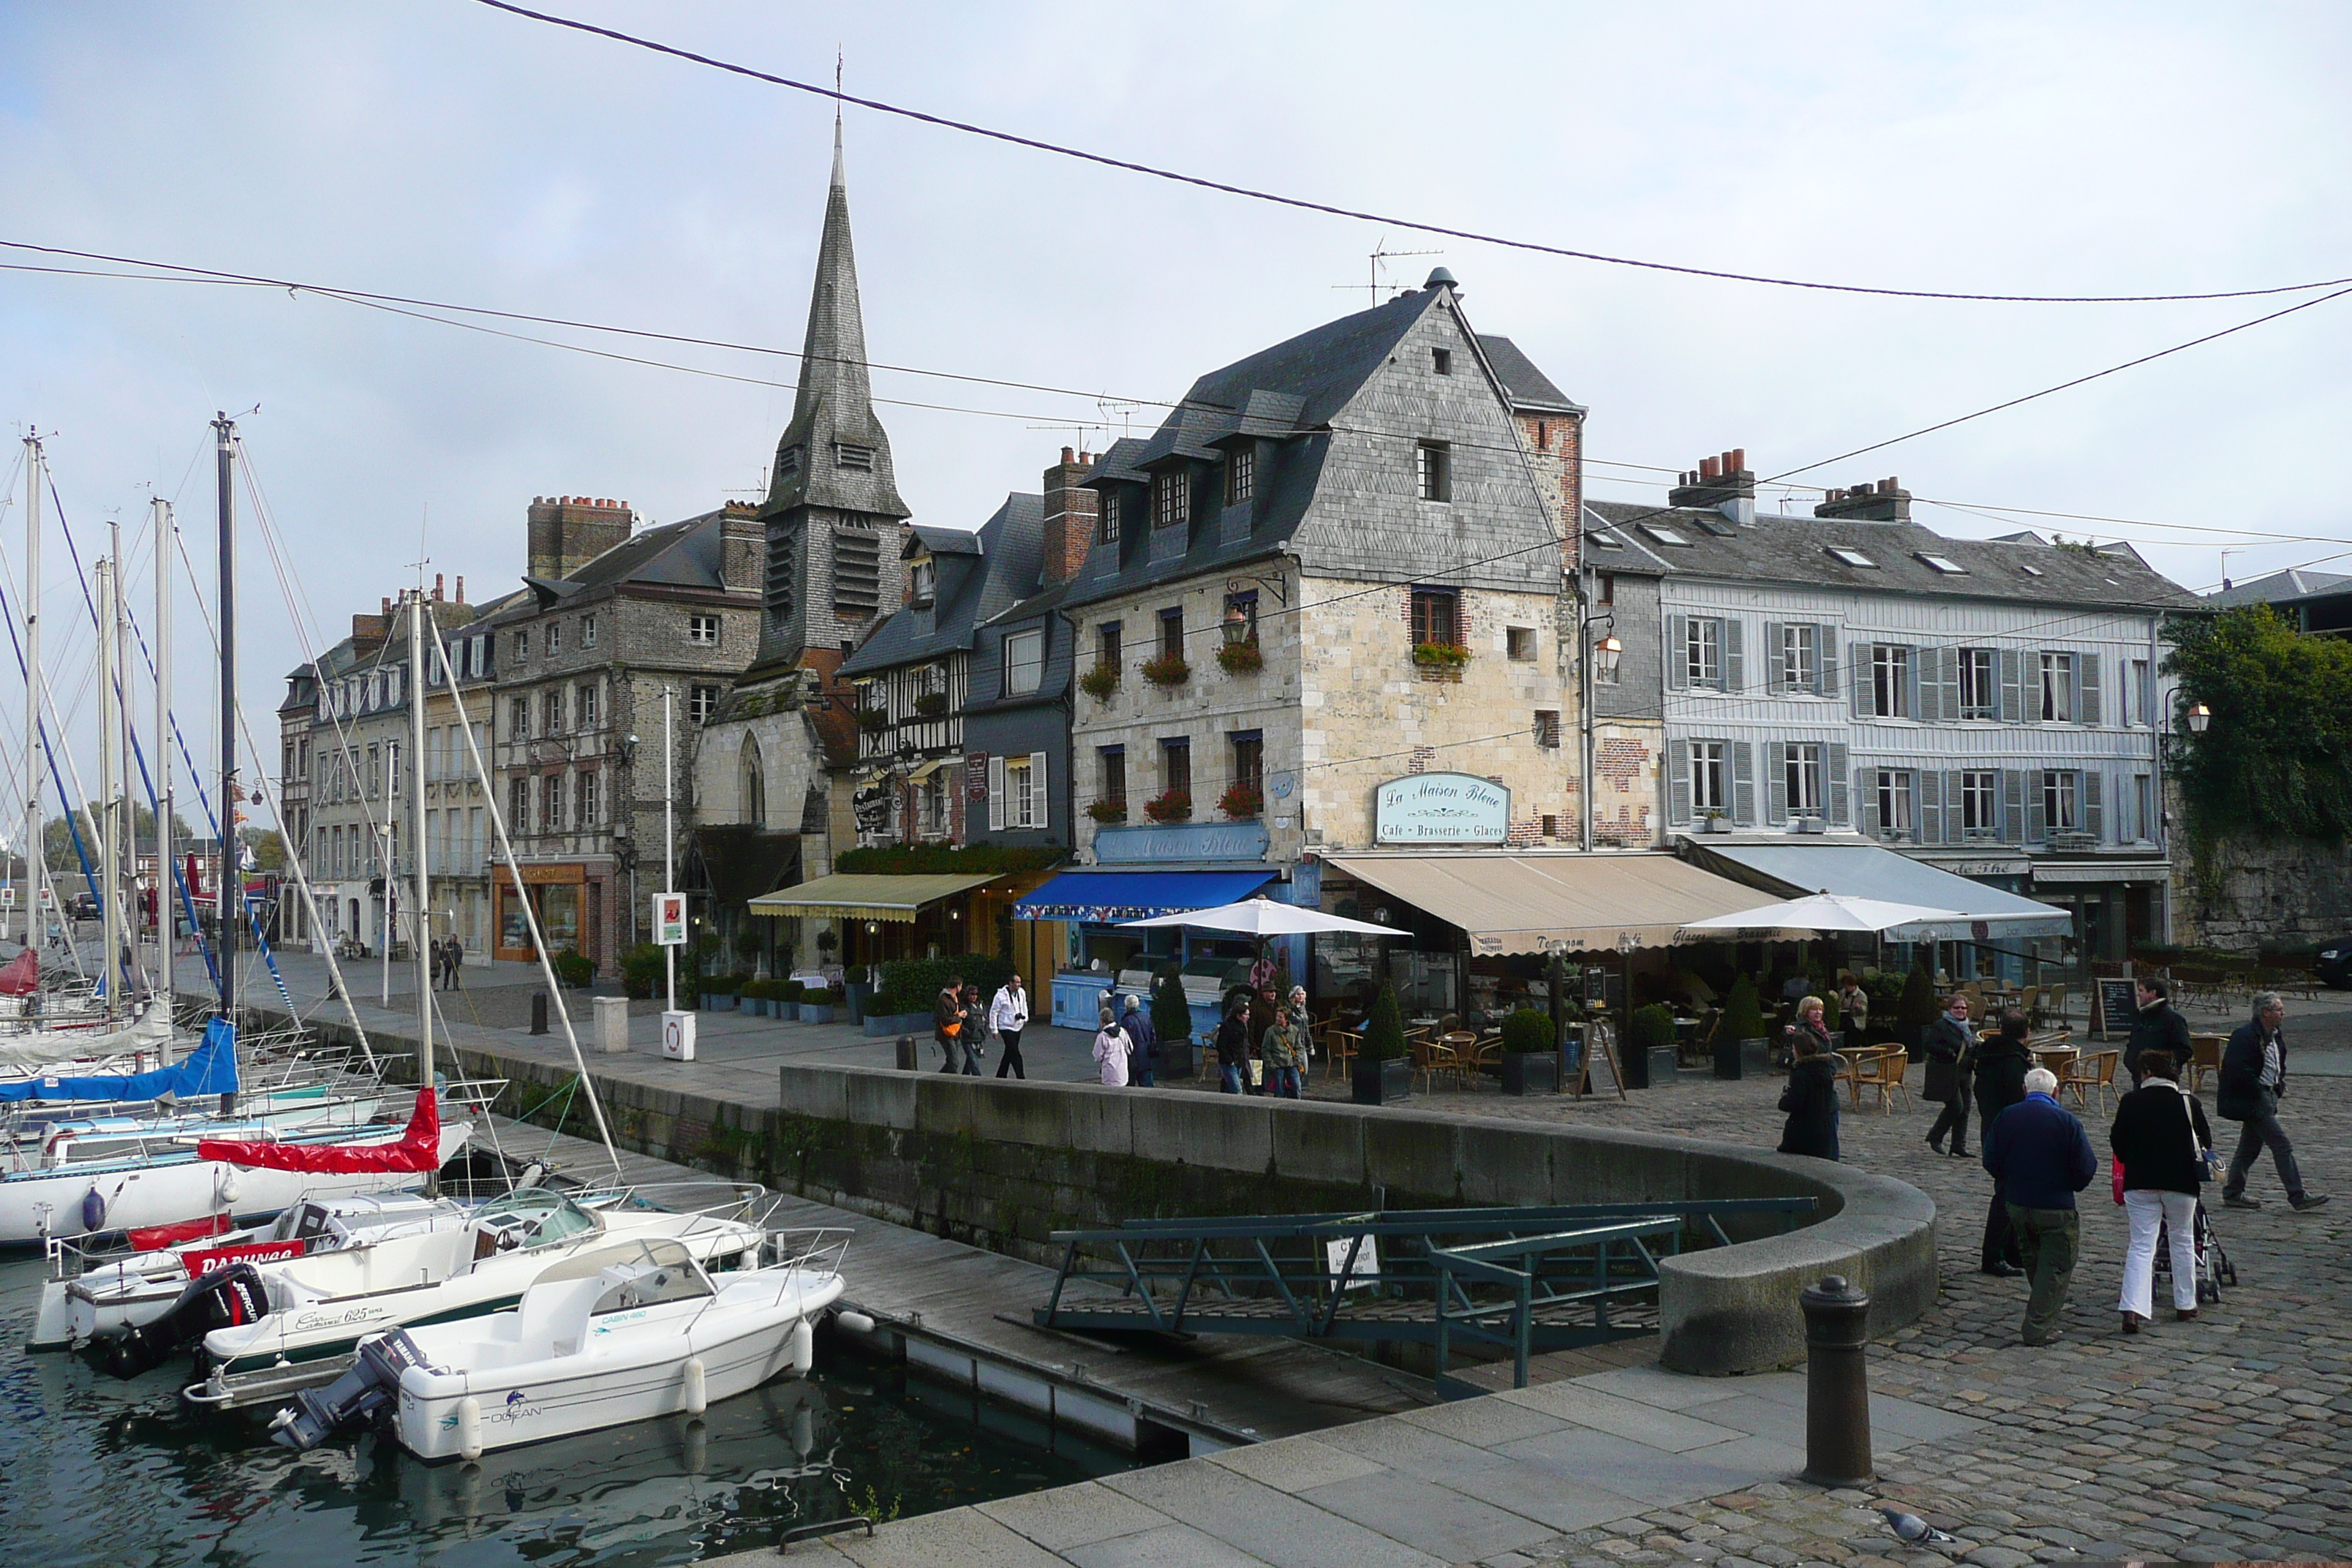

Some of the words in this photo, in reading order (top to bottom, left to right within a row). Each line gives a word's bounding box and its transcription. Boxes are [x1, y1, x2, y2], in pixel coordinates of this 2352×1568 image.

[1386, 788, 1403, 808] La
[1412, 781, 1458, 799] Maison
[1466, 784, 1500, 807] Bleue
[1417, 824, 1460, 837] Brasserie
[1474, 824, 1503, 836] Glaces
[1135, 831, 1192, 856] Maison
[1201, 829, 1250, 854] Bleue
[1977, 863, 2010, 874] Thé
[1673, 929, 1707, 945] Glaces
[1736, 927, 1782, 940] Brasserie
[238, 1282, 259, 1322] MERCUR
[344, 1307, 368, 1322] 625
[602, 1313, 628, 1324] CABIN
[393, 1338, 417, 1366] YAMAHA
[491, 1406, 542, 1423] OCEAN
